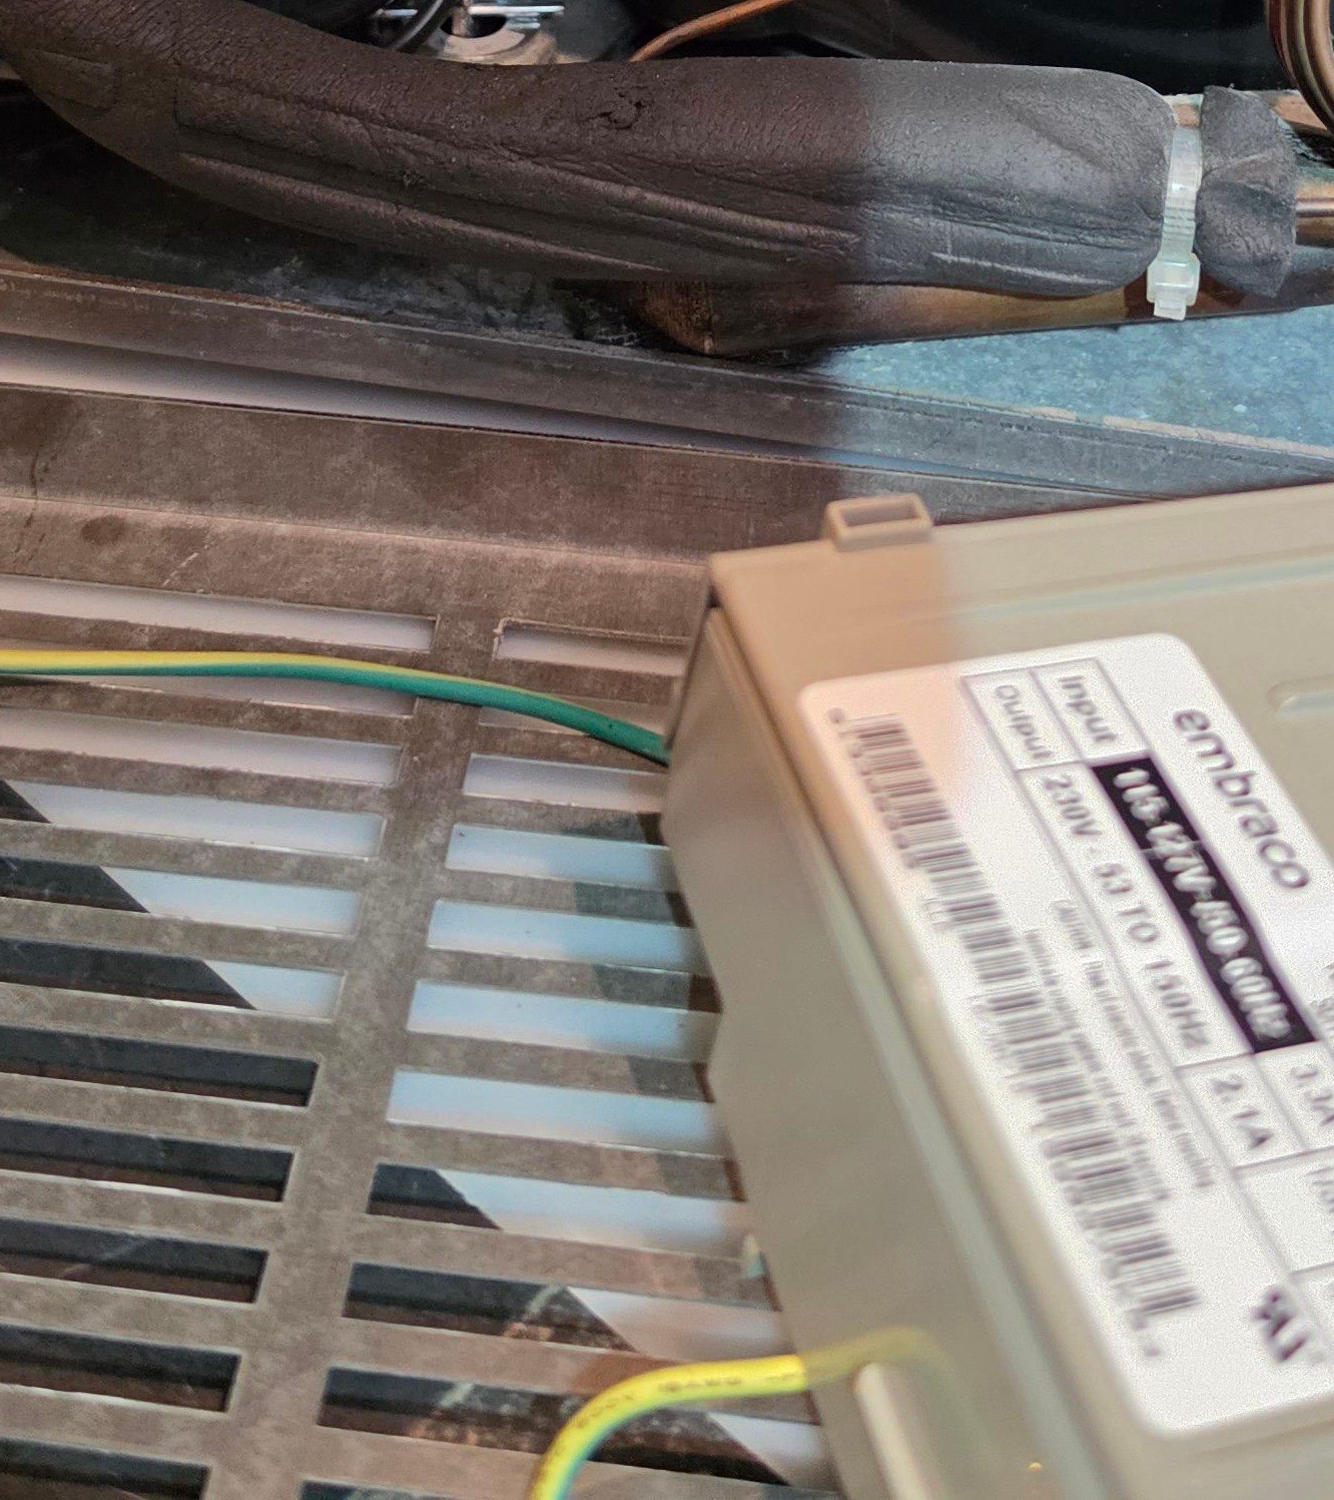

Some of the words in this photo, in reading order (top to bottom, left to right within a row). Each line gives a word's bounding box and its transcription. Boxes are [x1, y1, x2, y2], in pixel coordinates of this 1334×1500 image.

[1055, 676, 1118, 743] Input
[1174, 709, 1318, 889] embraco
[988, 685, 1053, 760] Output
[1042, 775, 1100, 837] 230V
[1091, 862, 1133, 896] 53
[1113, 900, 1161, 945] TO
[1141, 959, 1215, 1048] 150Hz
[1209, 1073, 1276, 1149] 2.1A
